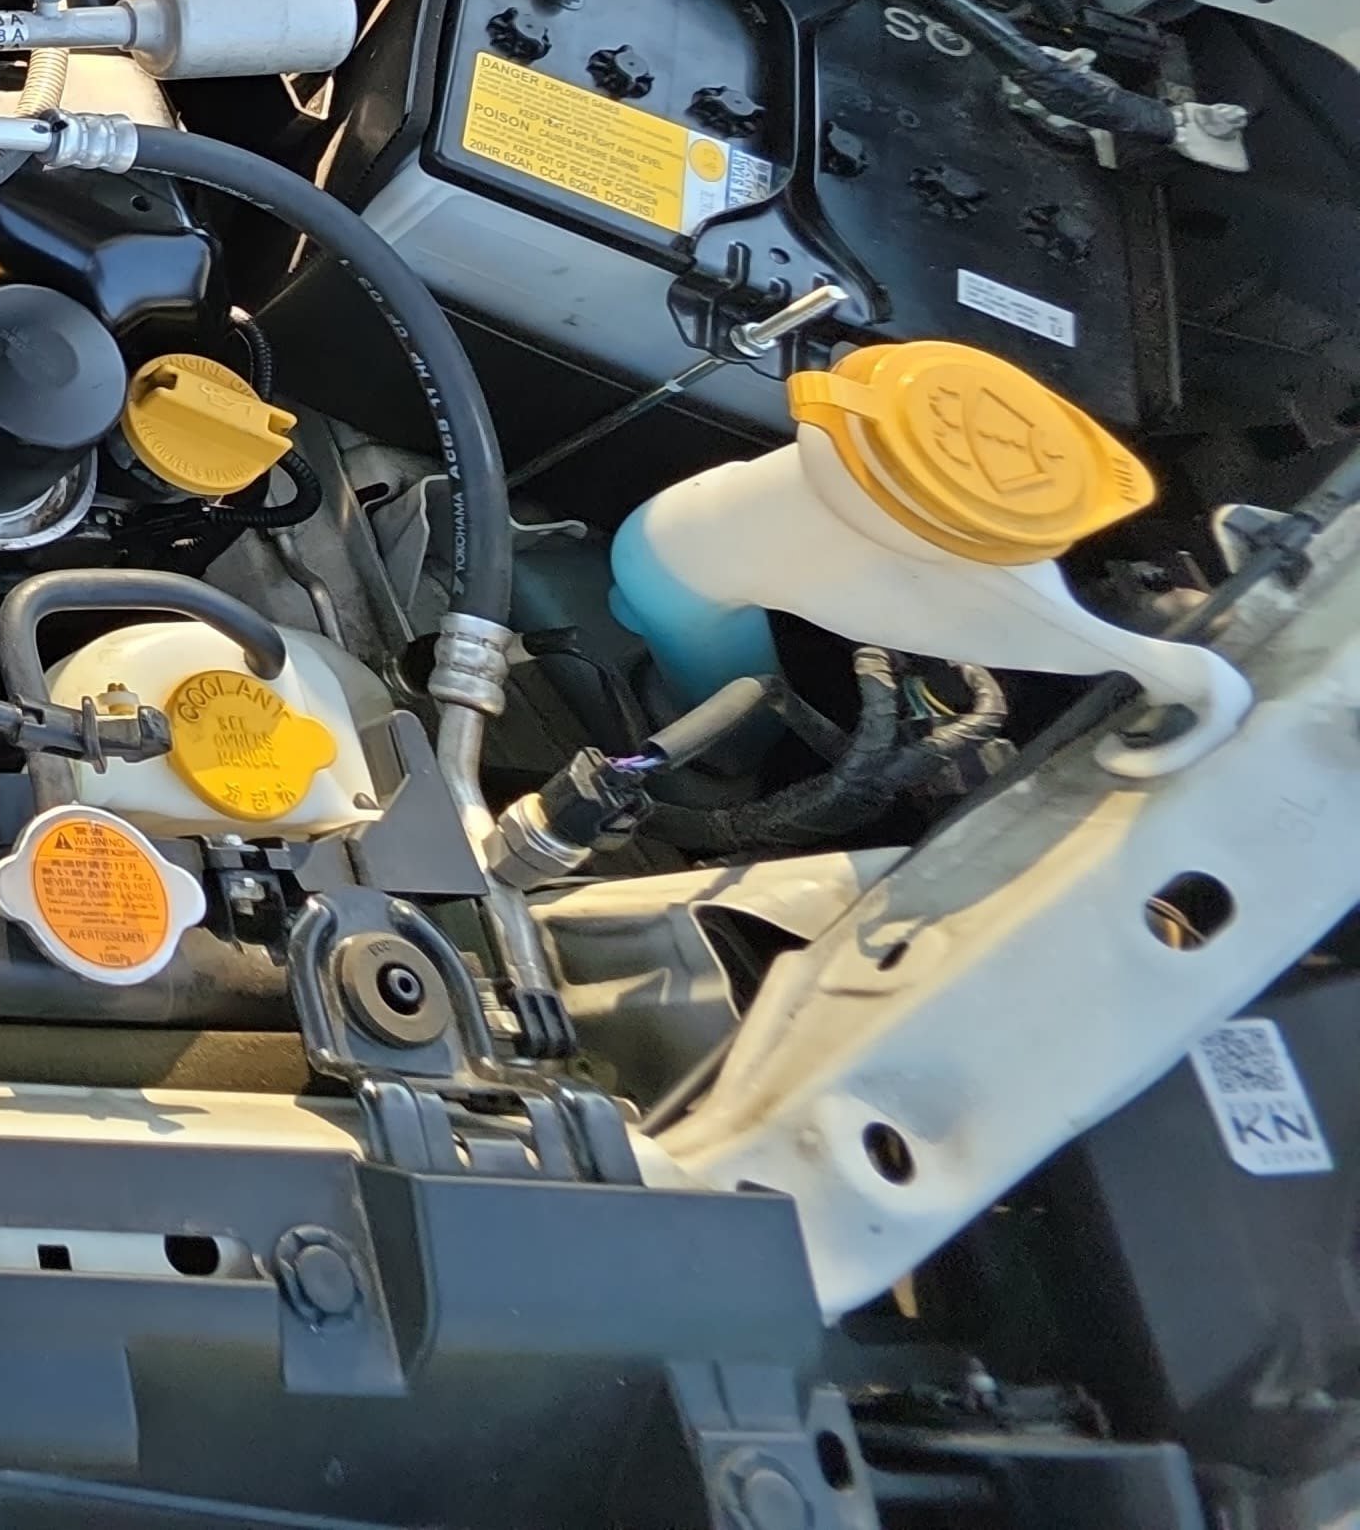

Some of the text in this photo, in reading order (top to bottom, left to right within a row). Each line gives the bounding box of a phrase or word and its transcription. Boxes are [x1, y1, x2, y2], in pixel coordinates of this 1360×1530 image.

[481, 56, 540, 86] DANGER
[473, 102, 531, 132] POISON
[519, 108, 540, 122] KEEP
[469, 138, 501, 160] 20HR
[503, 152, 533, 172] 62Ah
[539, 165, 567, 185] CCA
[568, 176, 599, 197] 620A
[454, 491, 466, 572] YOKOHAMA
[178, 675, 292, 723] COOLANT
[73, 837, 126, 848] WARNING
[42, 877, 153, 892] NEVER OPEN WHEN HOT
[68, 927, 150, 944] AVERTISSEMENT
[1230, 1112, 1316, 1144] KN
